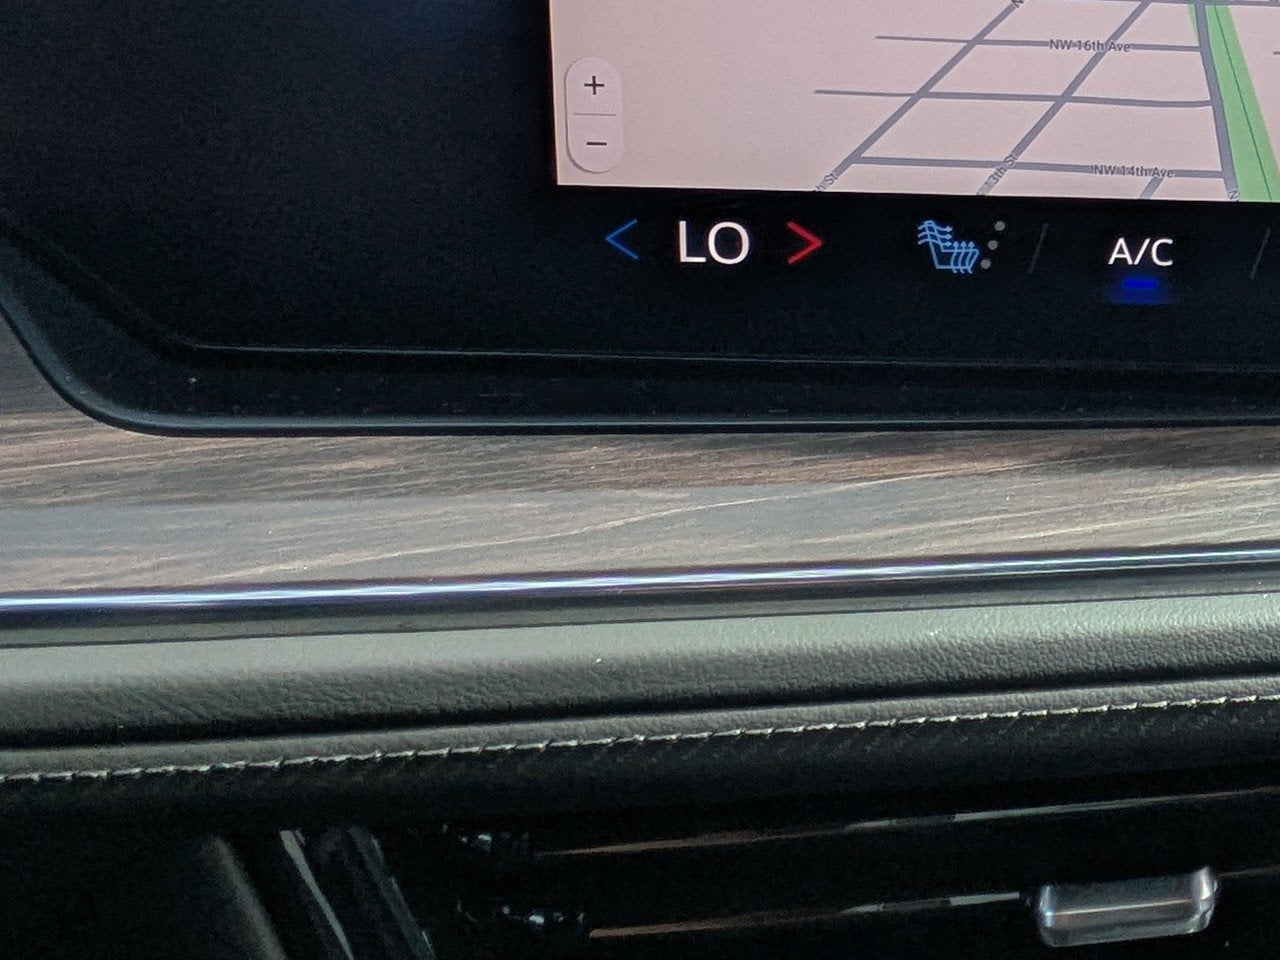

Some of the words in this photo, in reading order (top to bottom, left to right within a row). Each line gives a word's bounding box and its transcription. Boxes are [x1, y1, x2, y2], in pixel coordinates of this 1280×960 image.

[1050, 39, 1072, 51] NW
[1077, 39, 1106, 52] 16th
[1108, 41, 1131, 52] Ave
[1004, 153, 1018, 167] St
[1094, 164, 1117, 176] NW
[1121, 165, 1151, 178] 14th
[1151, 166, 1175, 178] Ave
[679, 220, 750, 265] LO
[1107, 237, 1174, 267] A/C
